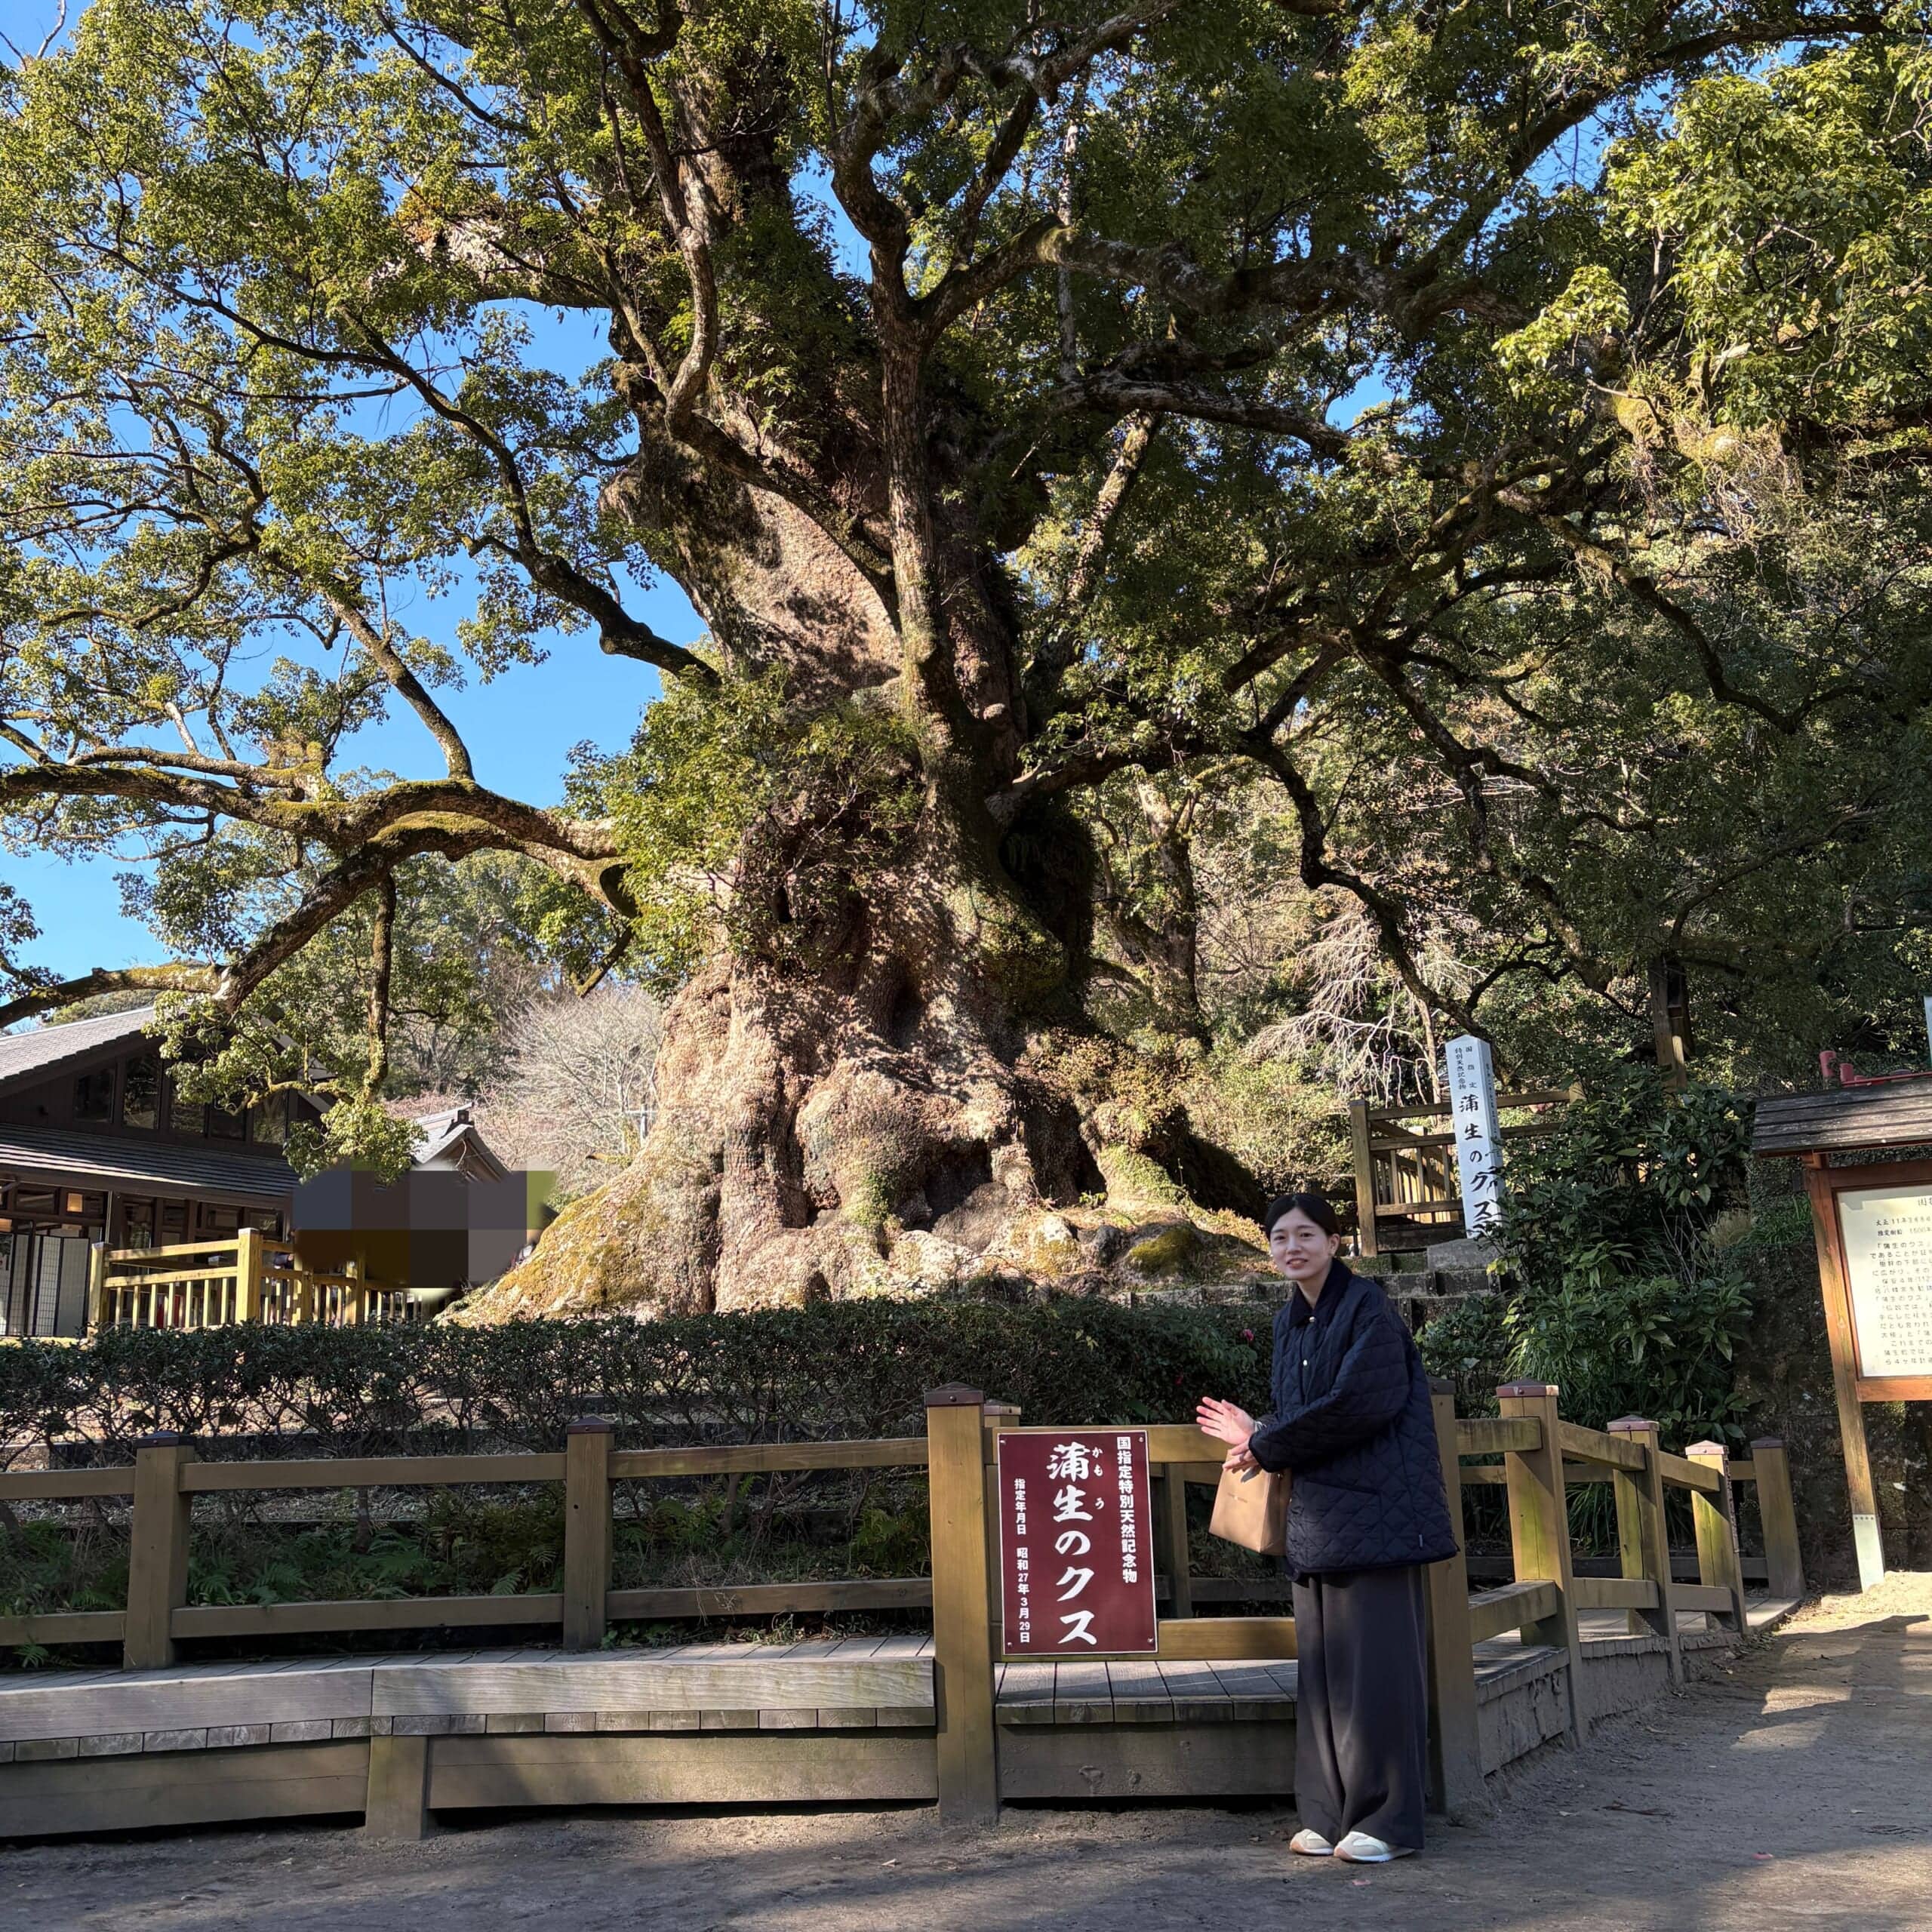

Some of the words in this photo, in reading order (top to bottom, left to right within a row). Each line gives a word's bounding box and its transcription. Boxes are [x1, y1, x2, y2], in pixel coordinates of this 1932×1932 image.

[1459, 1096, 1492, 1218] 蒲生のクス
[1014, 1478, 1027, 1535] 指定年月日
[1092, 1447, 1105, 1510] かもう
[1116, 1436, 1137, 1583] 国指定特別天然記念物
[1017, 1547, 1031, 1644] 昭和27年3月29日
[1046, 1441, 1097, 1645] 蒲生のクス
